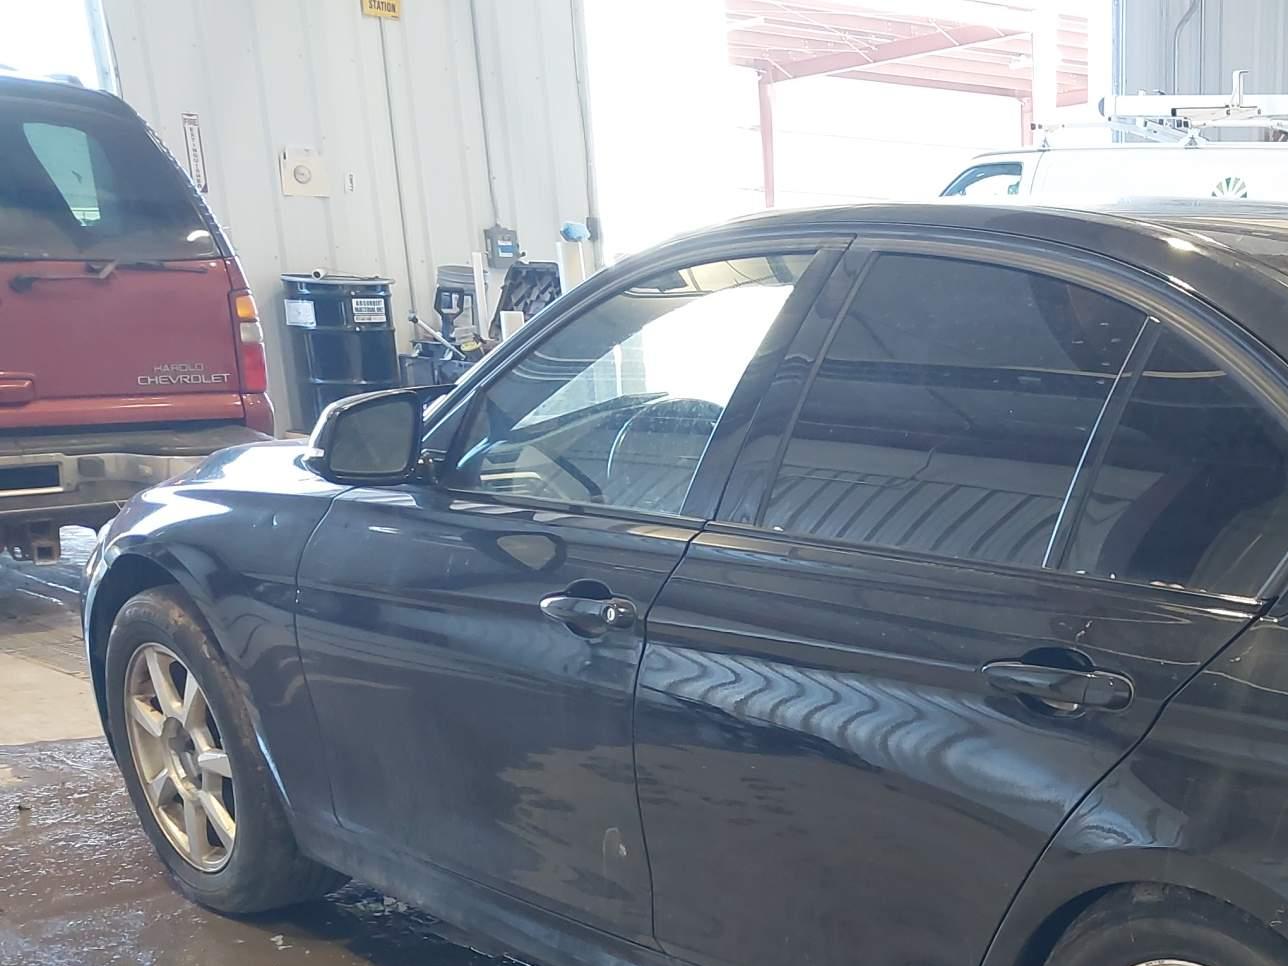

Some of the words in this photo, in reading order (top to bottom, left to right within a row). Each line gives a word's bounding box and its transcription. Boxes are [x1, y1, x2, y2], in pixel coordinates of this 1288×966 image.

[368, 0, 396, 13] STATION
[153, 363, 204, 373] HAROLD
[137, 373, 232, 385] CHEVROLET
